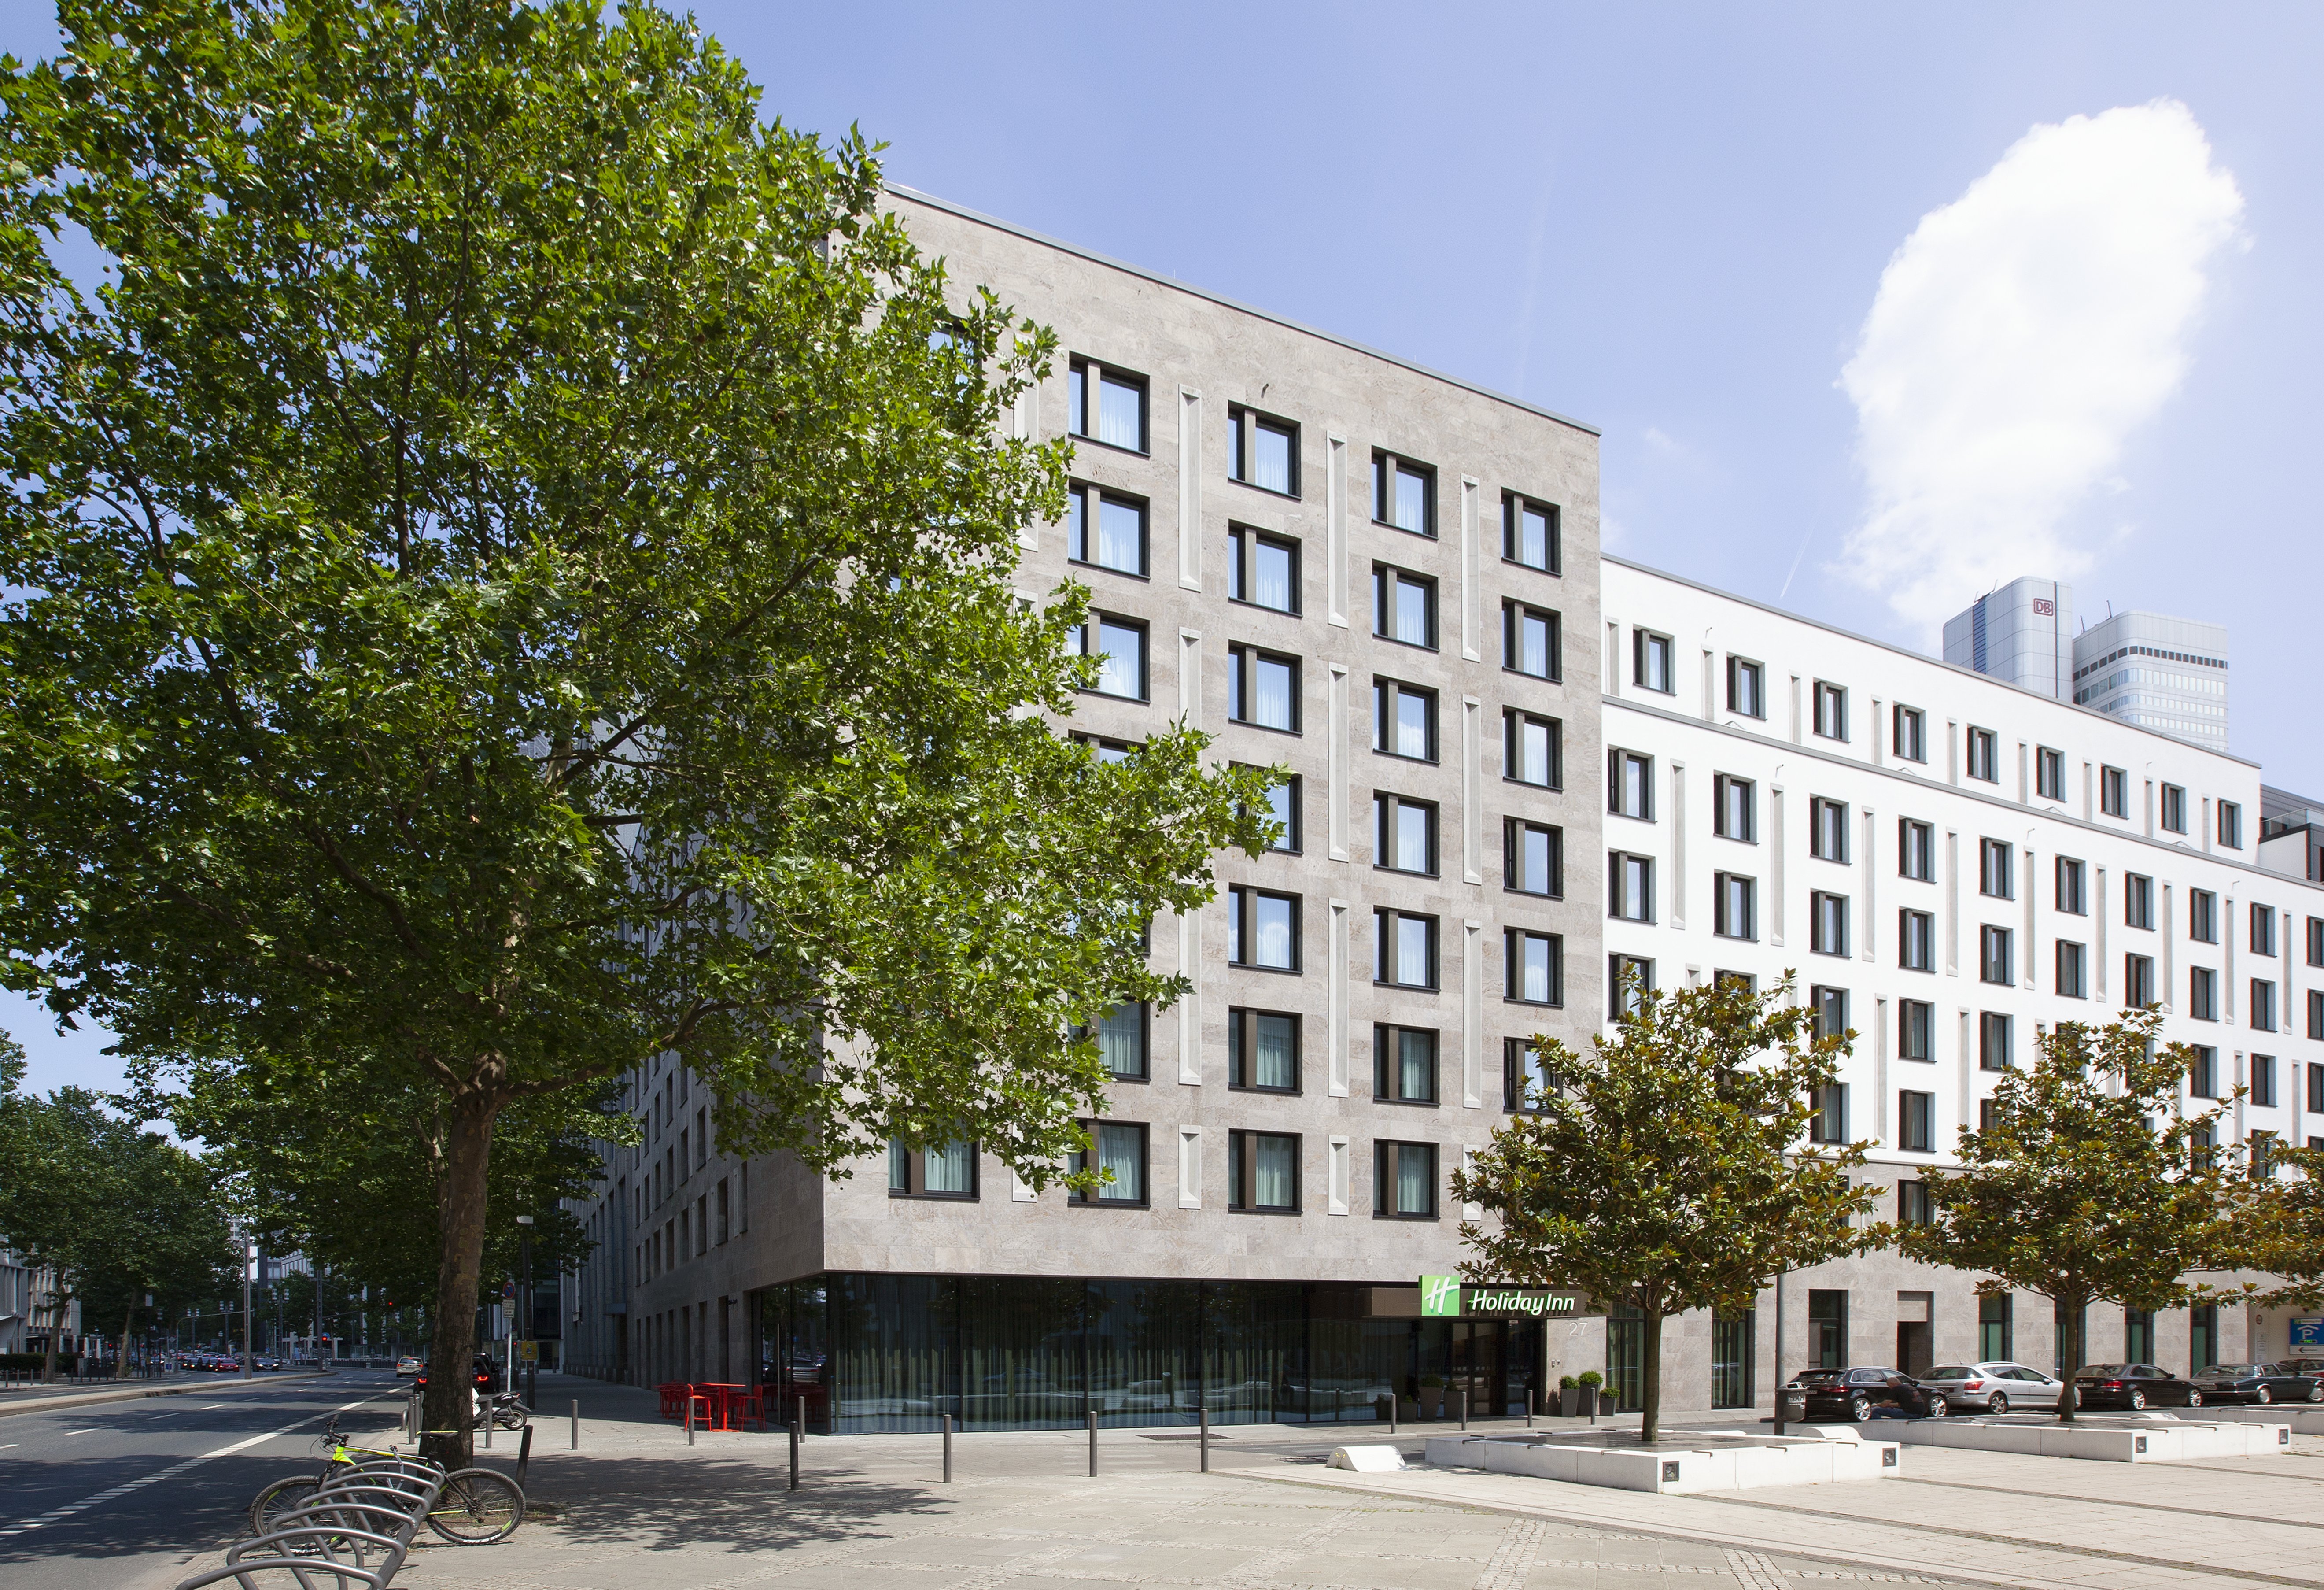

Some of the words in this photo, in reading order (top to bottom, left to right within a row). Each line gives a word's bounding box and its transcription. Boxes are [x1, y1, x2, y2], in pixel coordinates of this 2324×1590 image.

[2036, 601, 2051, 613] DB
[1470, 1290, 1544, 1316] Holiday
[1546, 1293, 1575, 1311] Inn
[1569, 1322, 1587, 1336] 27
[2302, 1329, 2314, 1339] P
